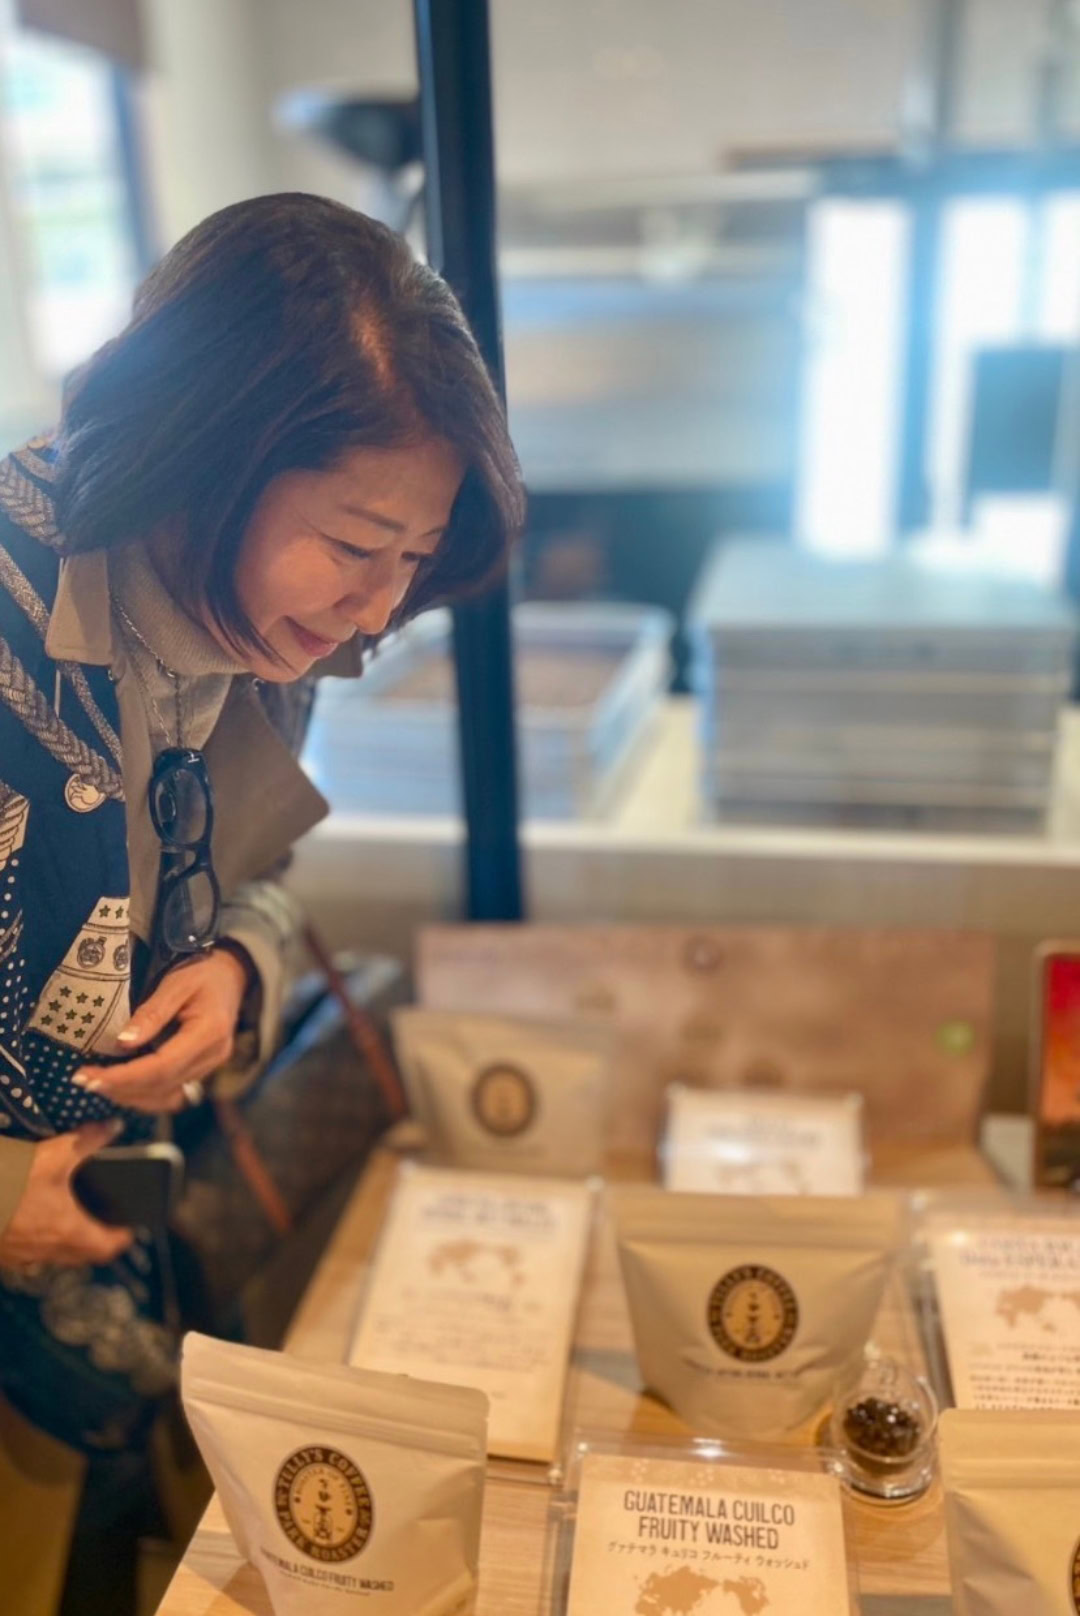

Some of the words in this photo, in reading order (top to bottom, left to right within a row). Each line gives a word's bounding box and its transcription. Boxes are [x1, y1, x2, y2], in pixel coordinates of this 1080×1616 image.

[623, 1489, 728, 1520] GUATEMALA
[732, 1499, 795, 1526] CUILCO
[637, 1516, 700, 1543] FRUITY
[705, 1521, 779, 1550] WASHED
[702, 1550, 751, 1565] フルーティ
